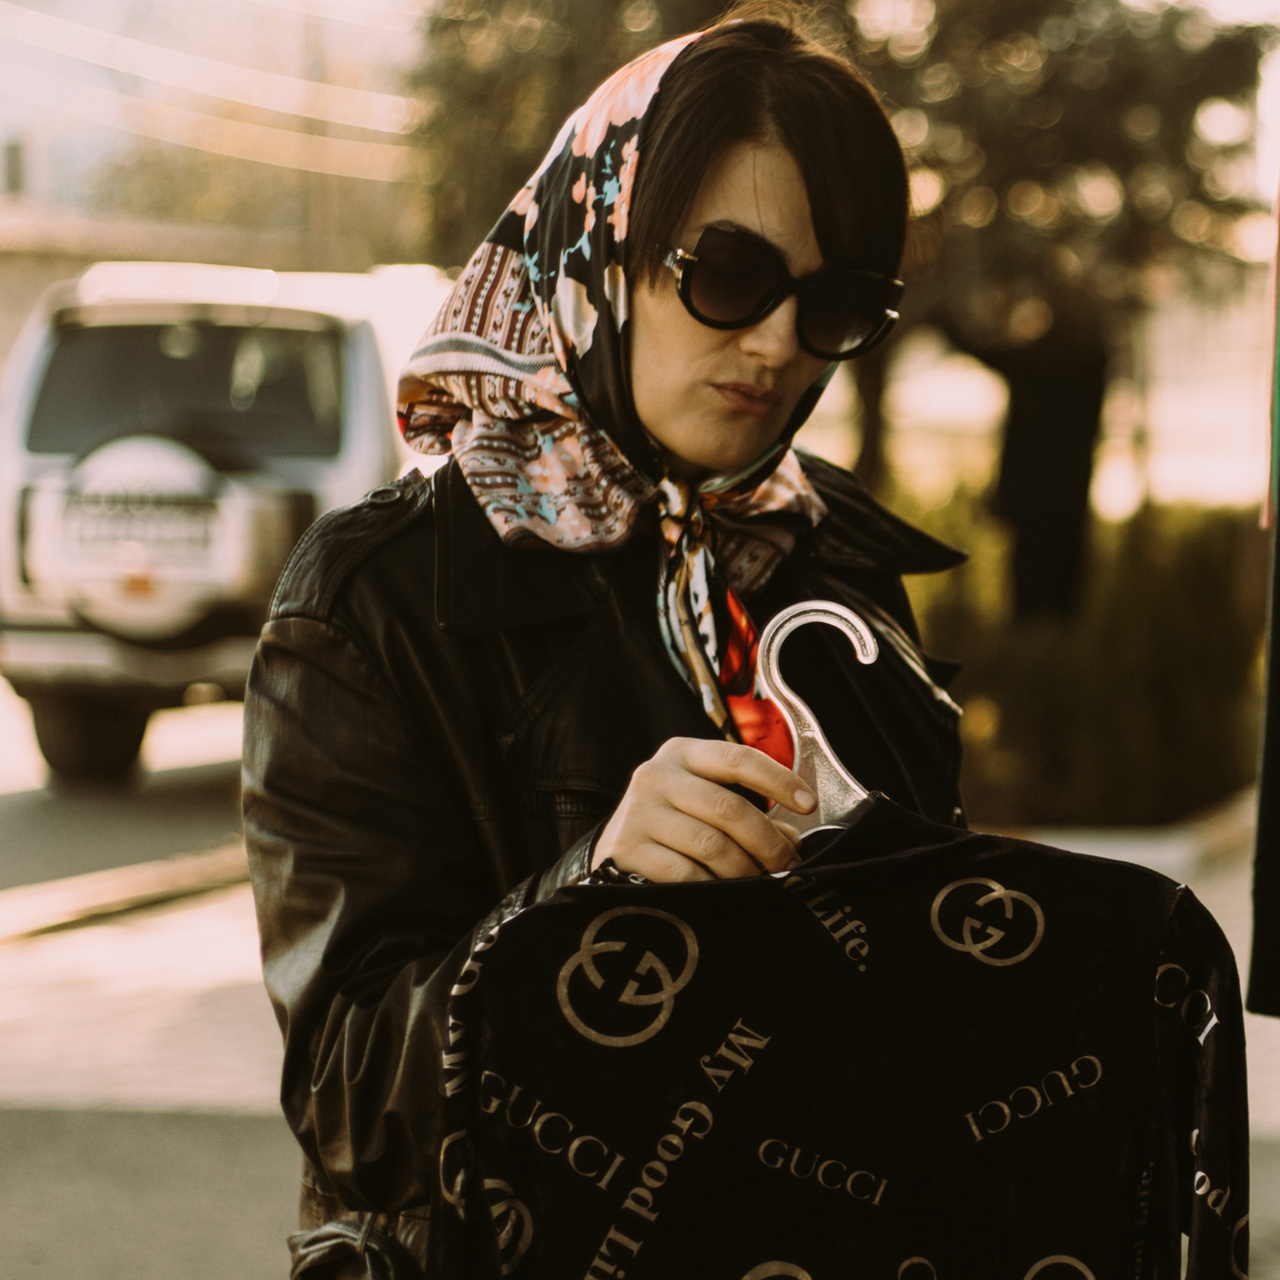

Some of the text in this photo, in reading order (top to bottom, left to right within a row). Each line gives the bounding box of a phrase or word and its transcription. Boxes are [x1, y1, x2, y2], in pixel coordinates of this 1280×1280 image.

[700, 1017, 772, 1093] My
[963, 1054, 1103, 1143] GUCCI
[481, 1070, 627, 1193] GUCCI
[621, 1099, 714, 1223] Good
[757, 1138, 890, 1207] GUCCI
